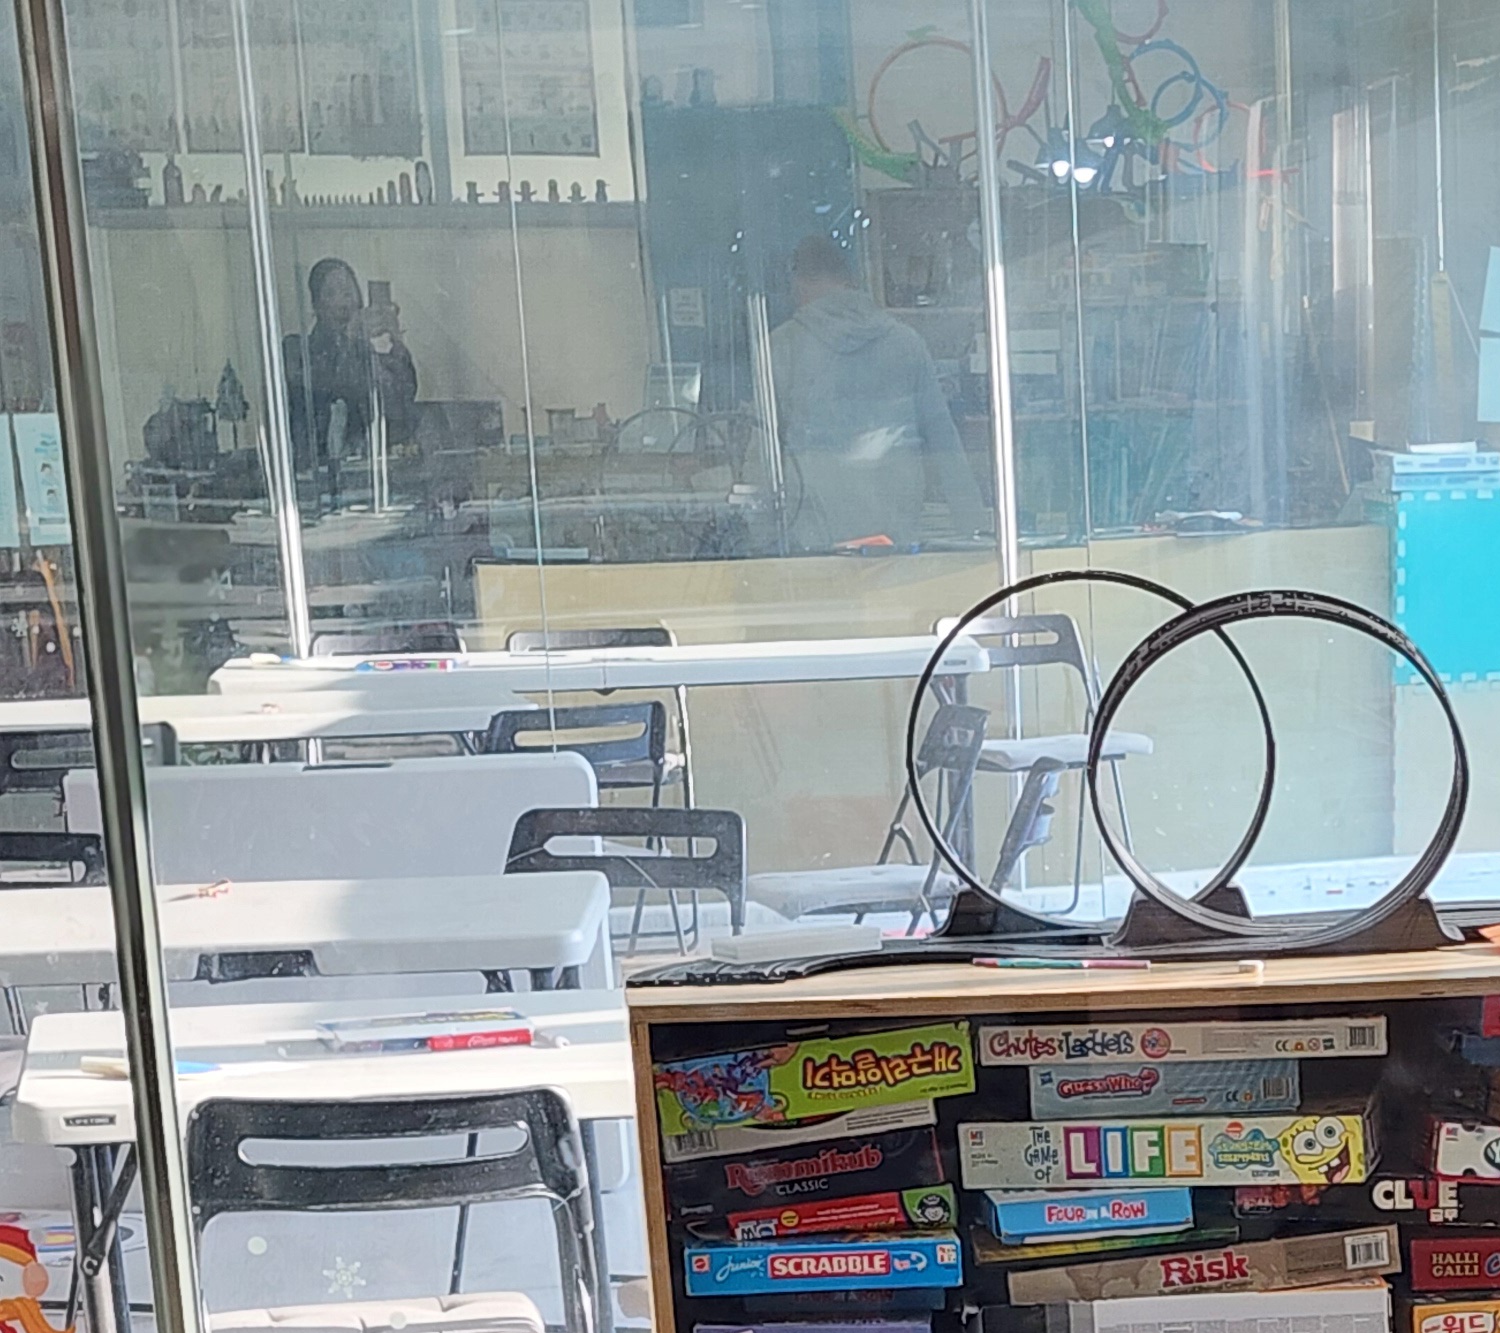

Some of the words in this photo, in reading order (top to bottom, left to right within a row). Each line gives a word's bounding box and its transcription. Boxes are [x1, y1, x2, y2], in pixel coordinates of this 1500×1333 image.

[988, 1030, 1057, 1060] Chutes
[1064, 1029, 1135, 1059] Ladders
[803, 1041, 961, 1089] 개구리알먹기
[1066, 1128, 1202, 1178] LIFE
[725, 1147, 884, 1196] Rummikub
[776, 1178, 829, 1196] CLASSIC
[1372, 1179, 1459, 1211] CLUE
[1046, 1205, 1086, 1223] FOUR
[1111, 1202, 1145, 1219] ROW
[716, 1256, 767, 1281] Junior
[773, 1253, 888, 1277] SCRABBLE
[1160, 1251, 1249, 1288] Risk
[1431, 1252, 1479, 1265] HALLI
[1431, 1264, 1479, 1277] GALLI
